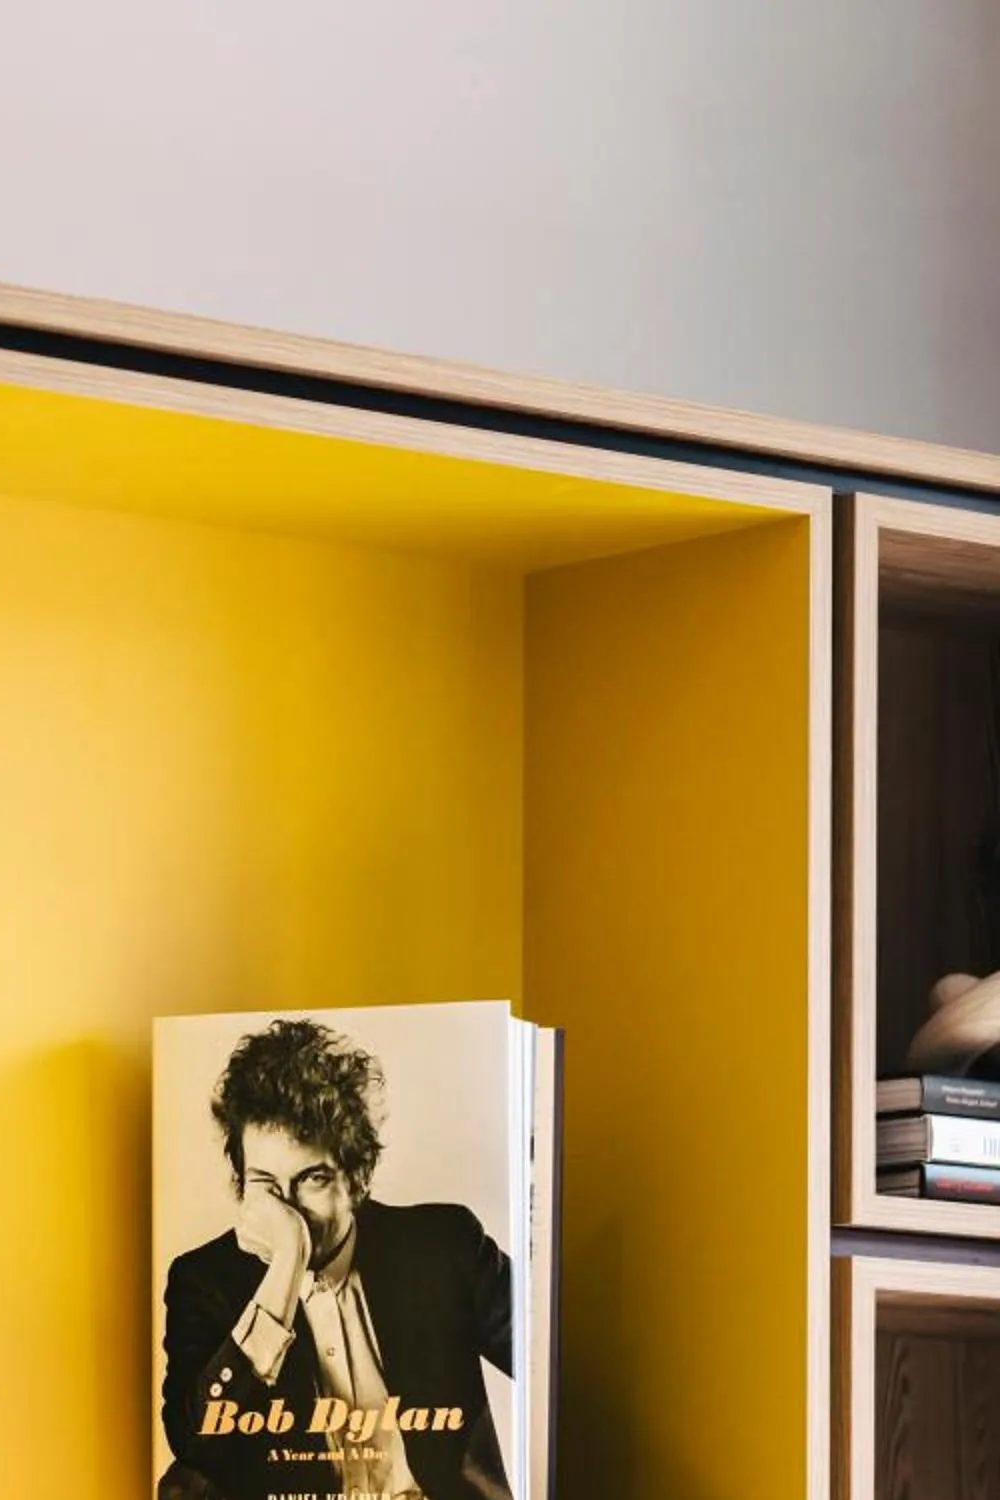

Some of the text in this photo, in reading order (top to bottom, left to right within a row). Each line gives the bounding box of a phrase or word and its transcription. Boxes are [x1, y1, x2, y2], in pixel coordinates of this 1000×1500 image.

[197, 1396, 465, 1443] Bob Dylan
[267, 1448, 279, 1462] A
[282, 1448, 315, 1461] Year
[318, 1448, 345, 1461] and
[347, 1447, 360, 1460] A
